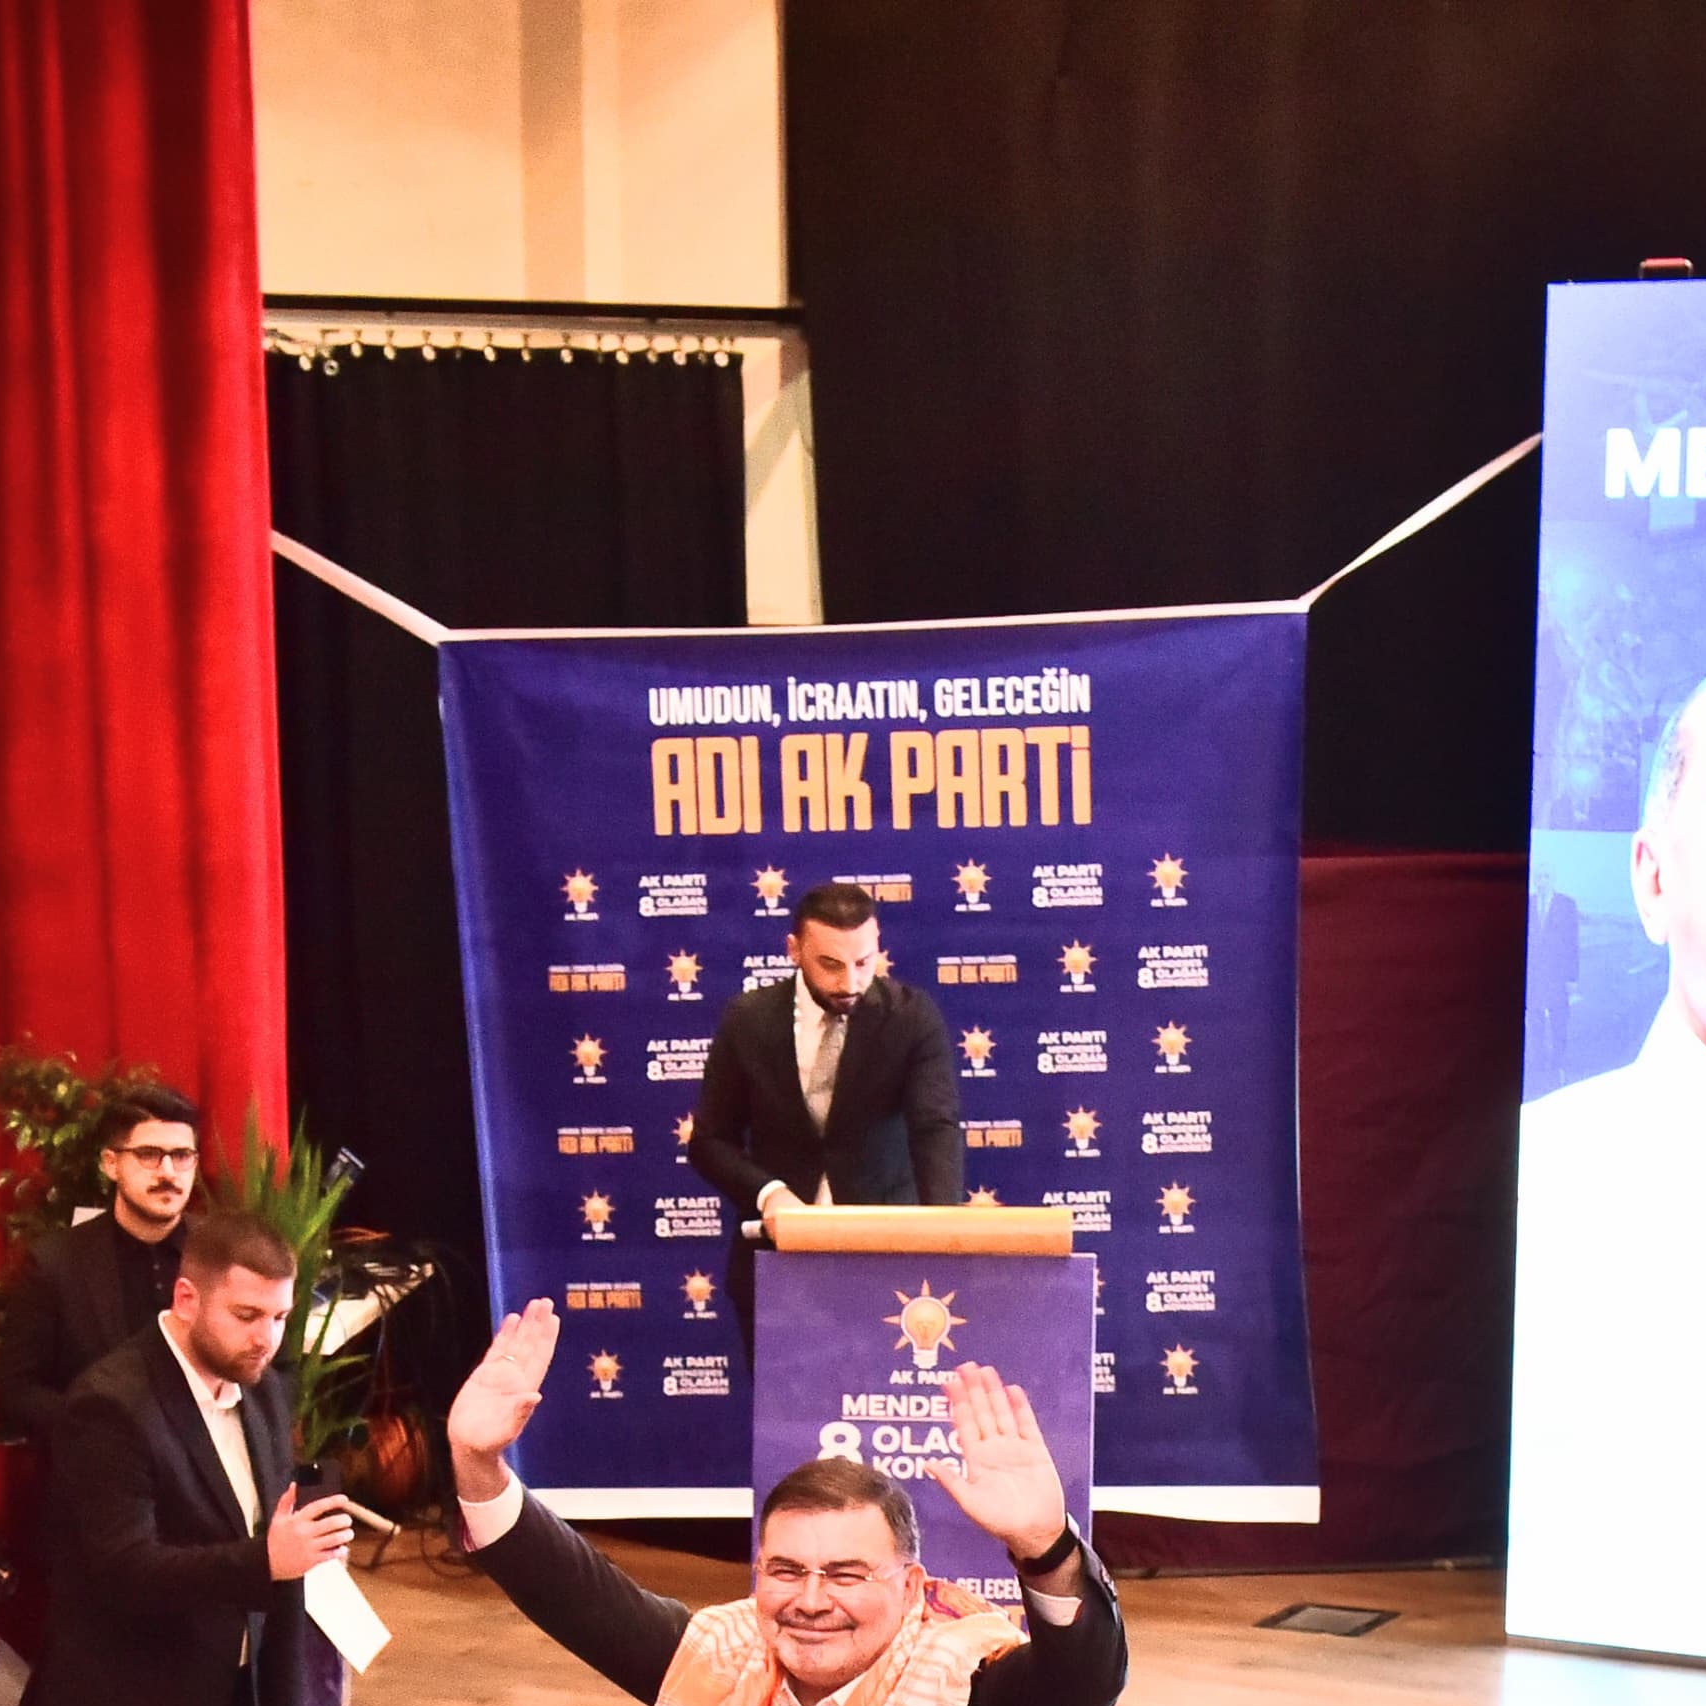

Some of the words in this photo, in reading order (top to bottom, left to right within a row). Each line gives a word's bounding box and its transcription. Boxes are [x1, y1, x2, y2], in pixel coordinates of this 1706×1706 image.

[648, 684, 781, 728] UMUDUN,
[787, 677, 928, 723] İCRAATIN,
[933, 667, 1091, 717] GELECEĞİN
[651, 735, 762, 836] ADI
[780, 732, 872, 833] AK
[890, 725, 1092, 831] PARTİ
[1032, 865, 1054, 877] AK
[639, 875, 660, 887] AK
[1138, 946, 1159, 958] AK
[1038, 1032, 1059, 1044] AK
[647, 1039, 668, 1052] AK
[1142, 1112, 1163, 1124] AK
[655, 1198, 675, 1209] AK
[1042, 1192, 1064, 1203] AK
[1146, 1272, 1167, 1284] AK
[664, 1358, 684, 1369] AK
[889, 1370, 914, 1385] AK
[842, 1394, 951, 1418] MENDE
